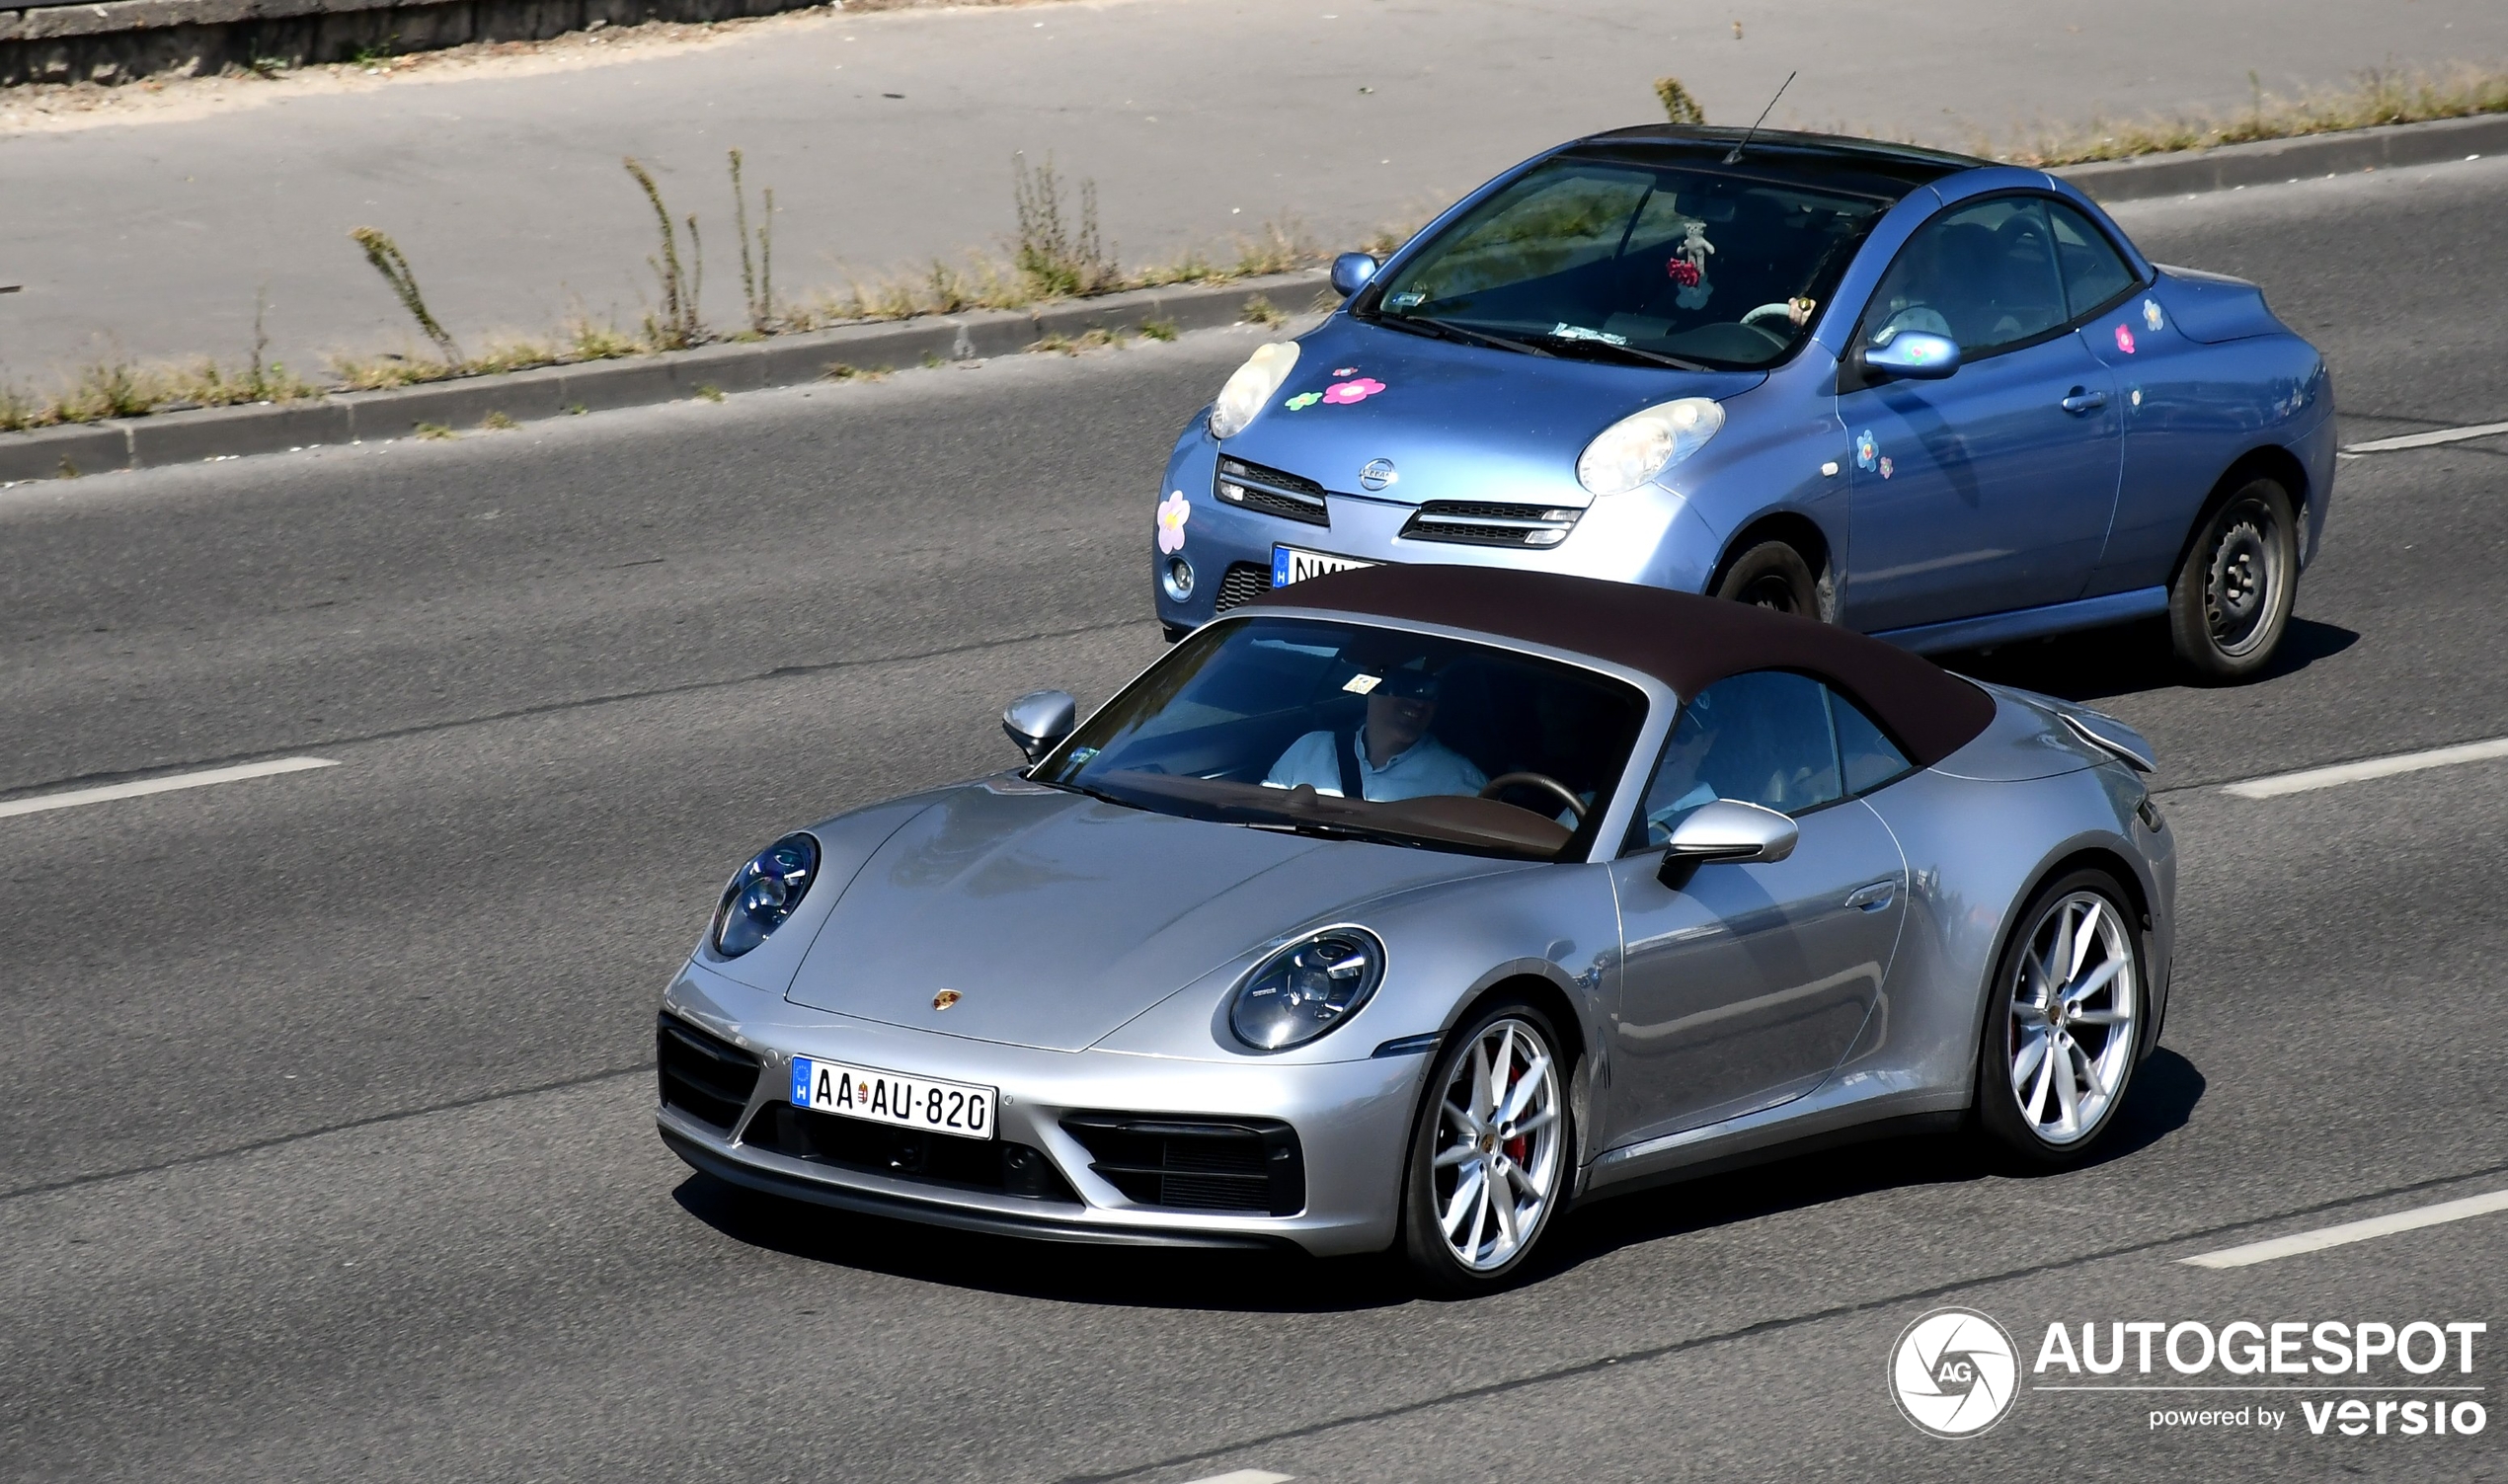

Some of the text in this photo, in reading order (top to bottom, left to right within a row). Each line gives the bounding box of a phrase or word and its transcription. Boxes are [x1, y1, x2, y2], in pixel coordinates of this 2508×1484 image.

[1277, 570, 1285, 584] H
[797, 1084, 807, 1101] H
[816, 1068, 985, 1131] AA AU-820
